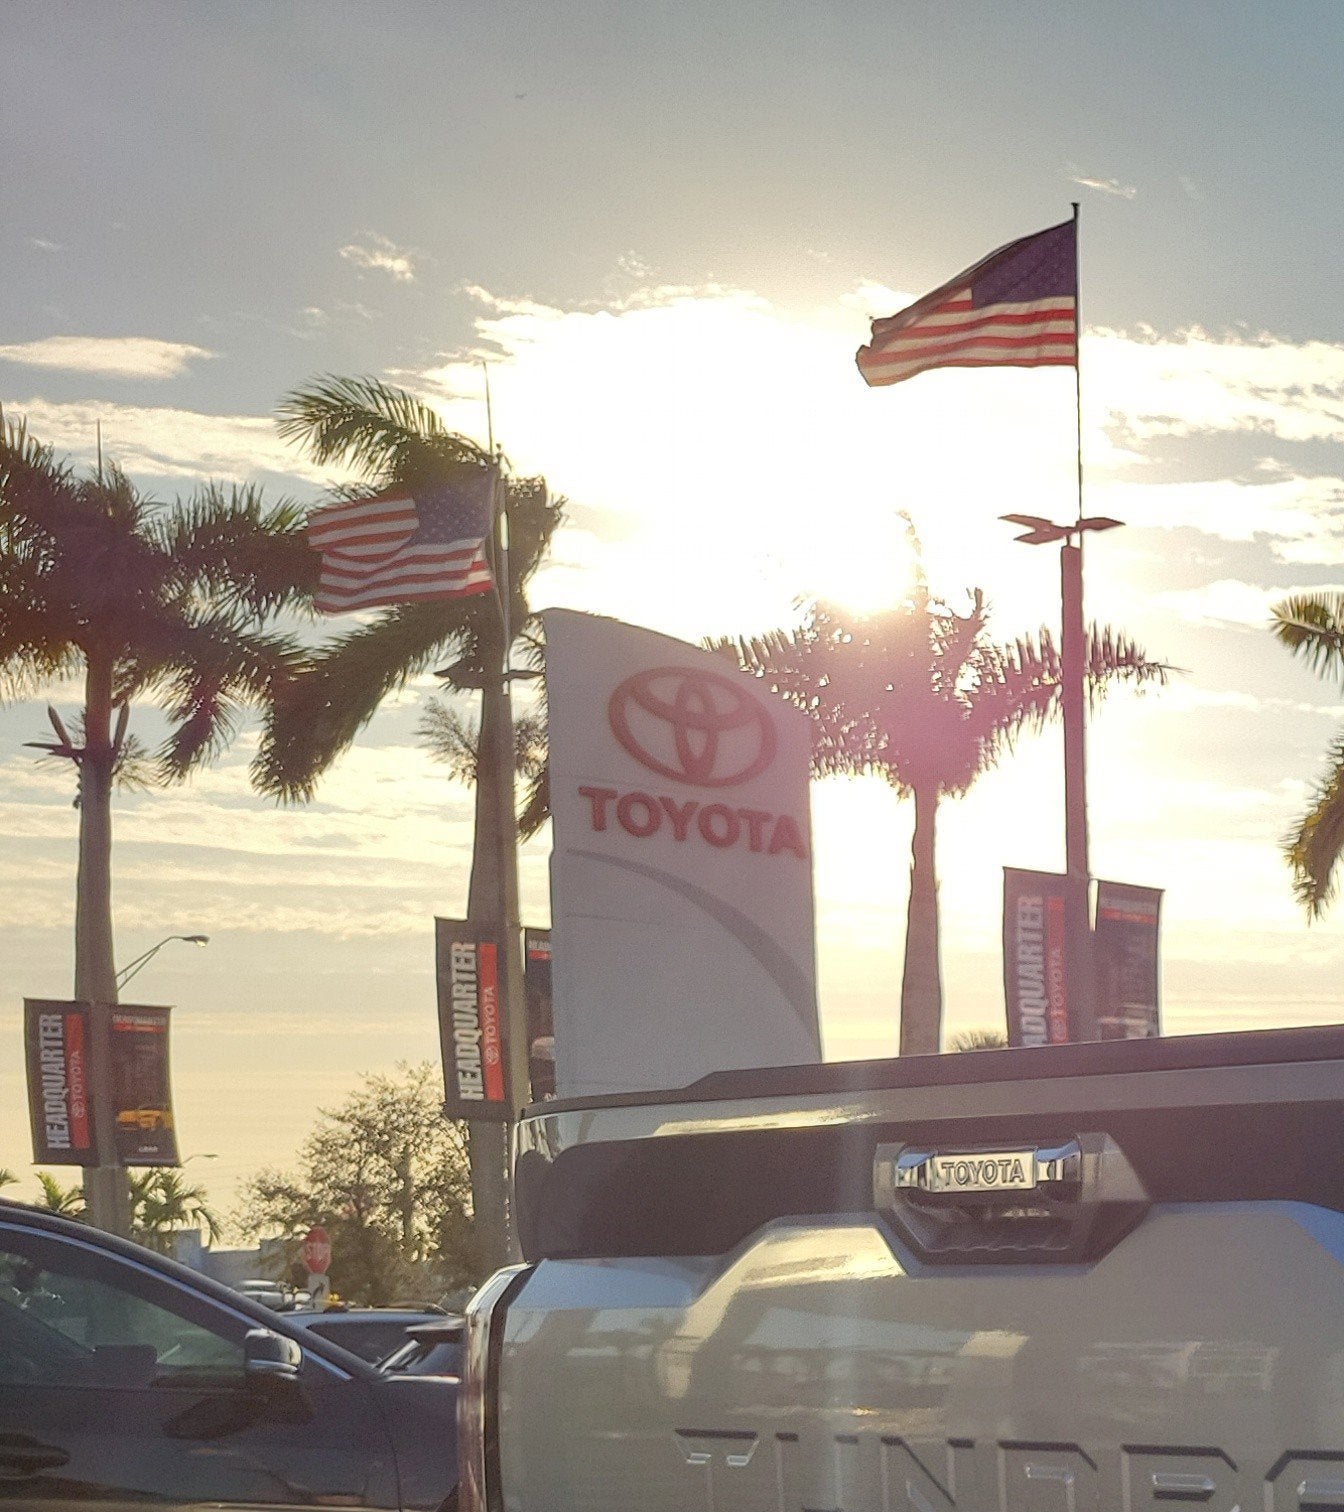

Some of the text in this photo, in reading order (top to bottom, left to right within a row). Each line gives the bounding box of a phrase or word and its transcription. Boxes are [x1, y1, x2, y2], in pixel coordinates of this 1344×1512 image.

[577, 786, 808, 860] TOYOTA
[1017, 896, 1048, 1045] ADQUARTER
[451, 942, 484, 1100] HEADQUARTER
[483, 986, 498, 1043] TOYOTA
[39, 1014, 70, 1148] HEADQUARTER
[70, 1051, 86, 1101] TOYOTA
[941, 1158, 1026, 1186] TOYOTA
